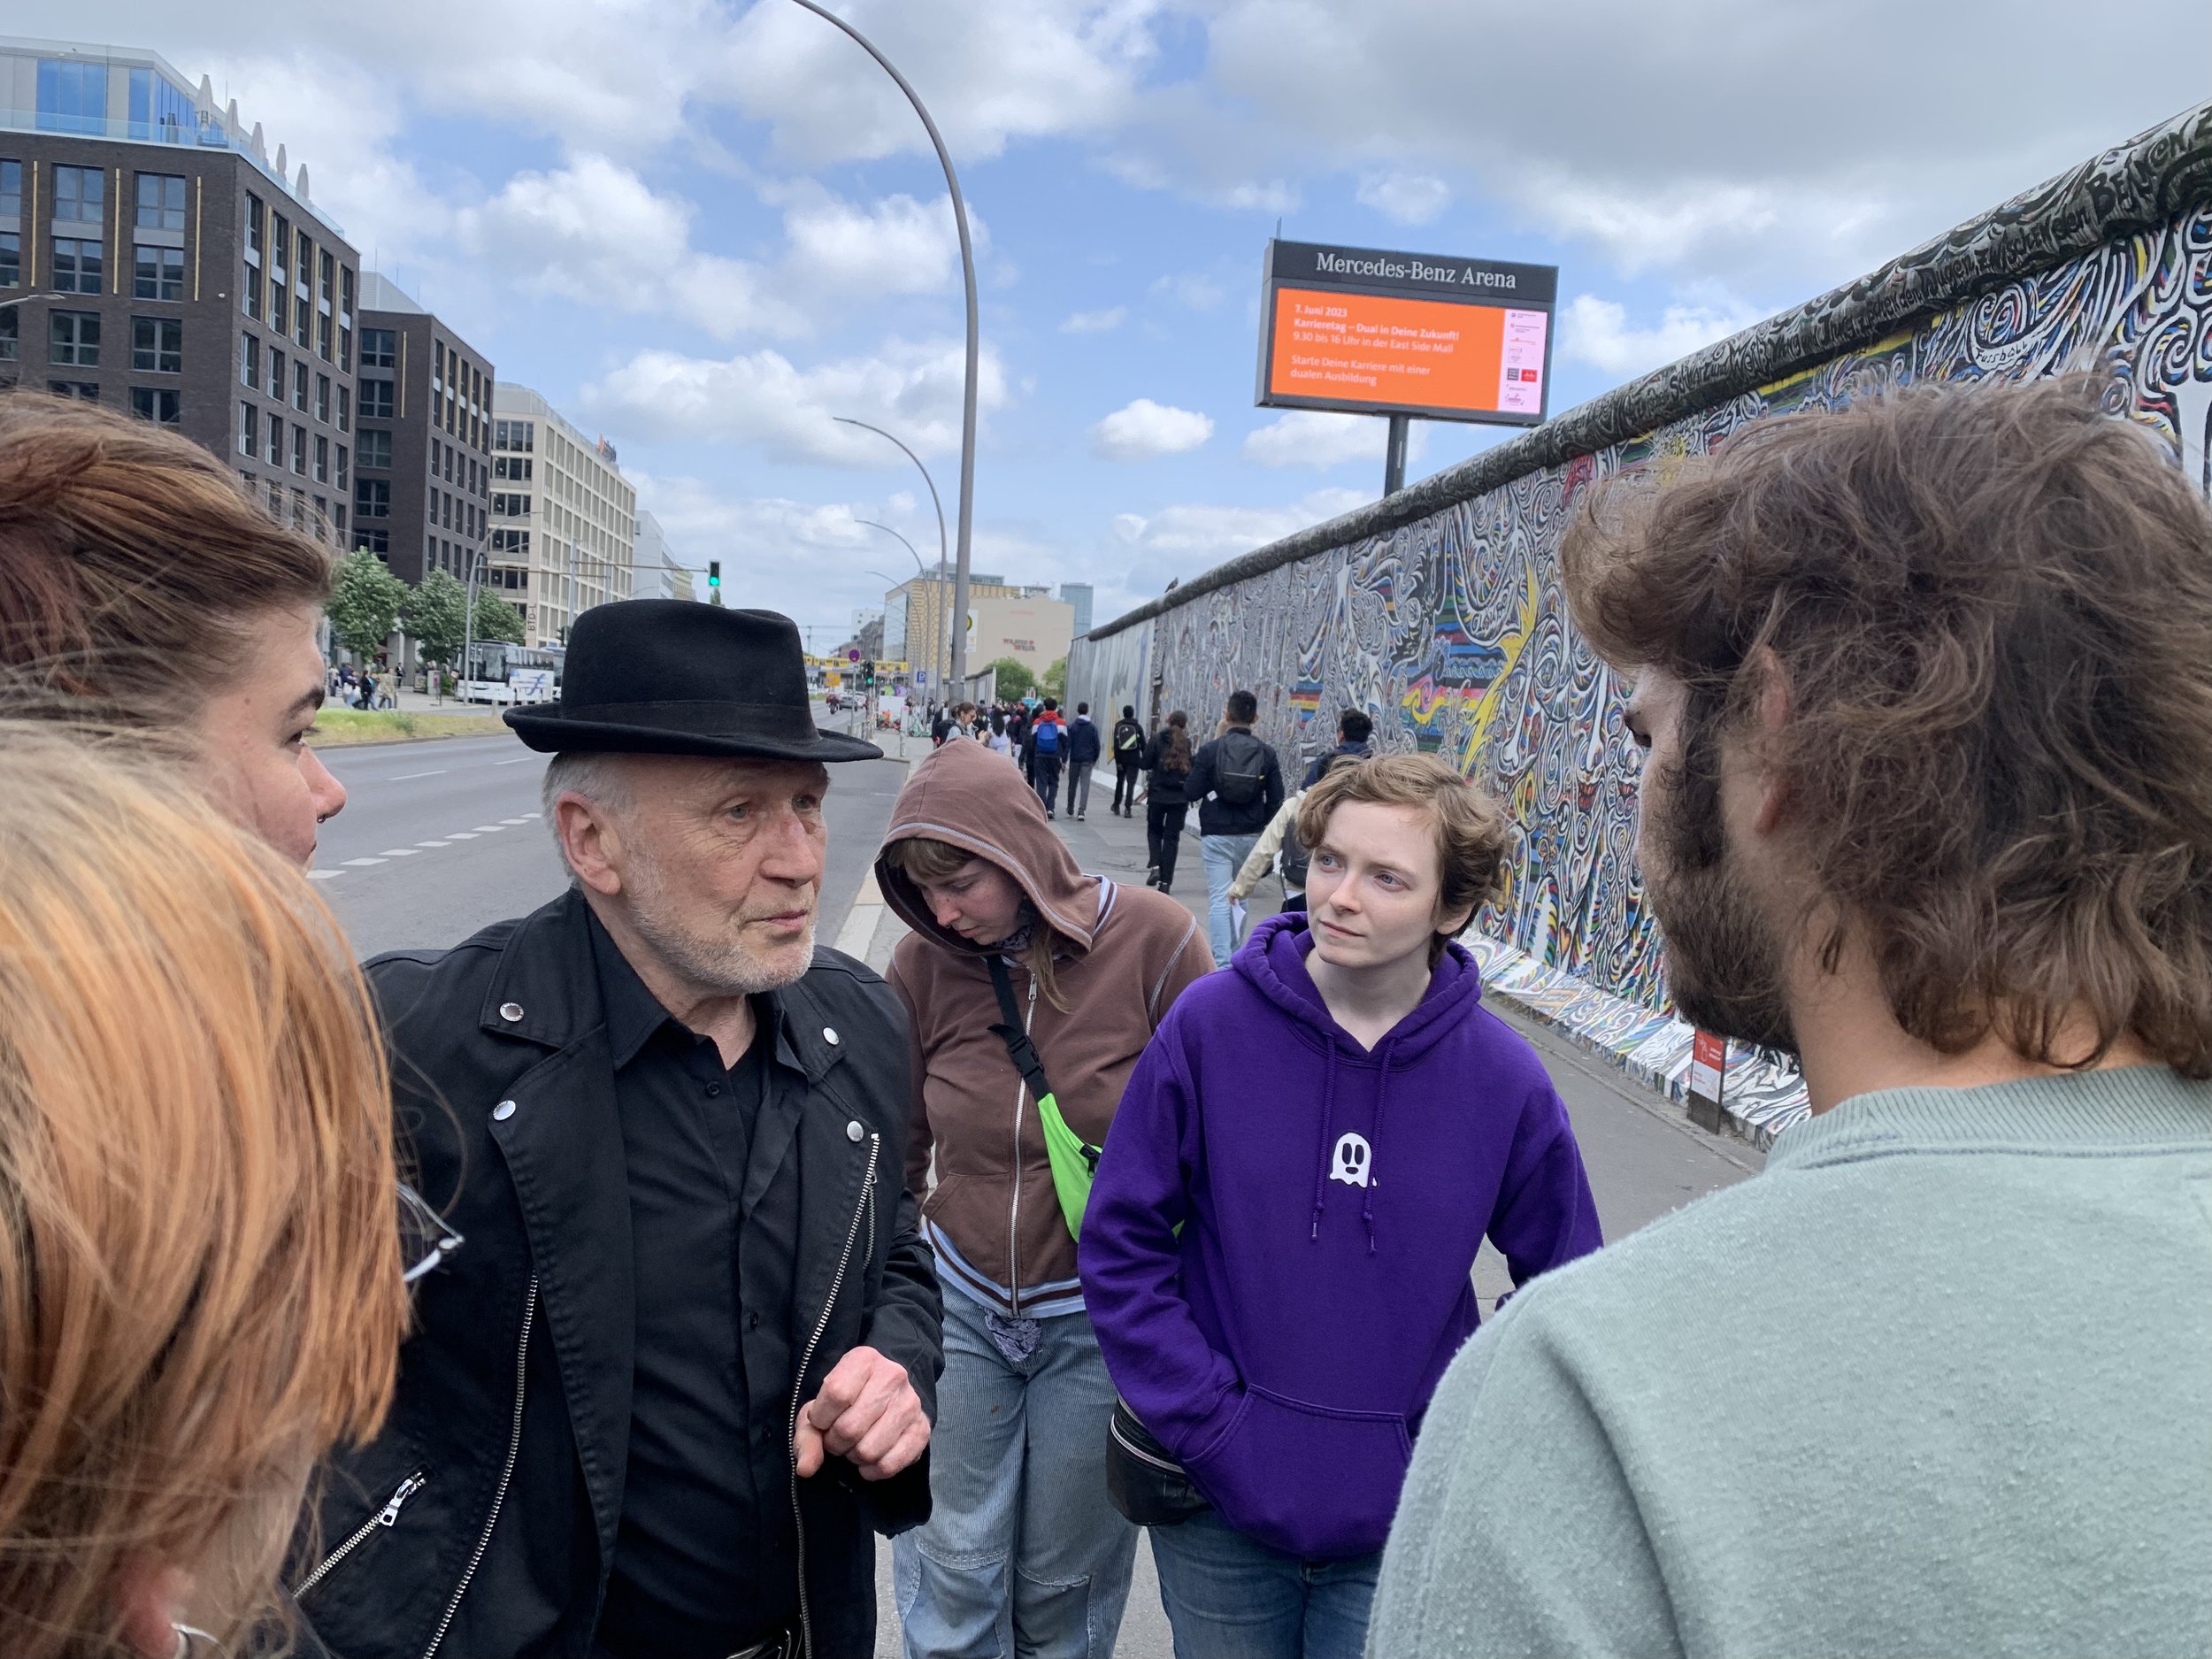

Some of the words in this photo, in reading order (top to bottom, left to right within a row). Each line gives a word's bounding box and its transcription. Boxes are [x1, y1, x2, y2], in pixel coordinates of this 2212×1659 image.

[1316, 252, 1456, 283] Mercedes-Benz
[1461, 266, 1517, 289] Arena
[1303, 305, 1324, 315] Juni
[1325, 307, 1348, 318] 2023
[1294, 319, 1347, 333] Karrieretag
[1356, 323, 1379, 334] Dual
[1380, 325, 1389, 334] in
[1392, 326, 1417, 337] Deine
[1420, 328, 1460, 341] Zukunft!
[1293, 331, 1313, 342] 9.30
[1315, 333, 1328, 343] bis
[1331, 334, 1340, 344] 16
[1343, 335, 1360, 345] Uhr
[1363, 337, 1371, 346] in
[1373, 338, 1388, 348] der
[1390, 339, 1409, 349] East
[1412, 341, 1431, 351] Side
[1433, 342, 1454, 353] Mall
[1292, 355, 1320, 365] Starte
[1322, 357, 1348, 368] Deine
[1351, 360, 1387, 371] Karriere
[1389, 363, 1405, 373] mit
[1407, 365, 1431, 375] einer
[1291, 368, 1323, 379] dualen
[1325, 371, 1378, 387] Ausbildung
